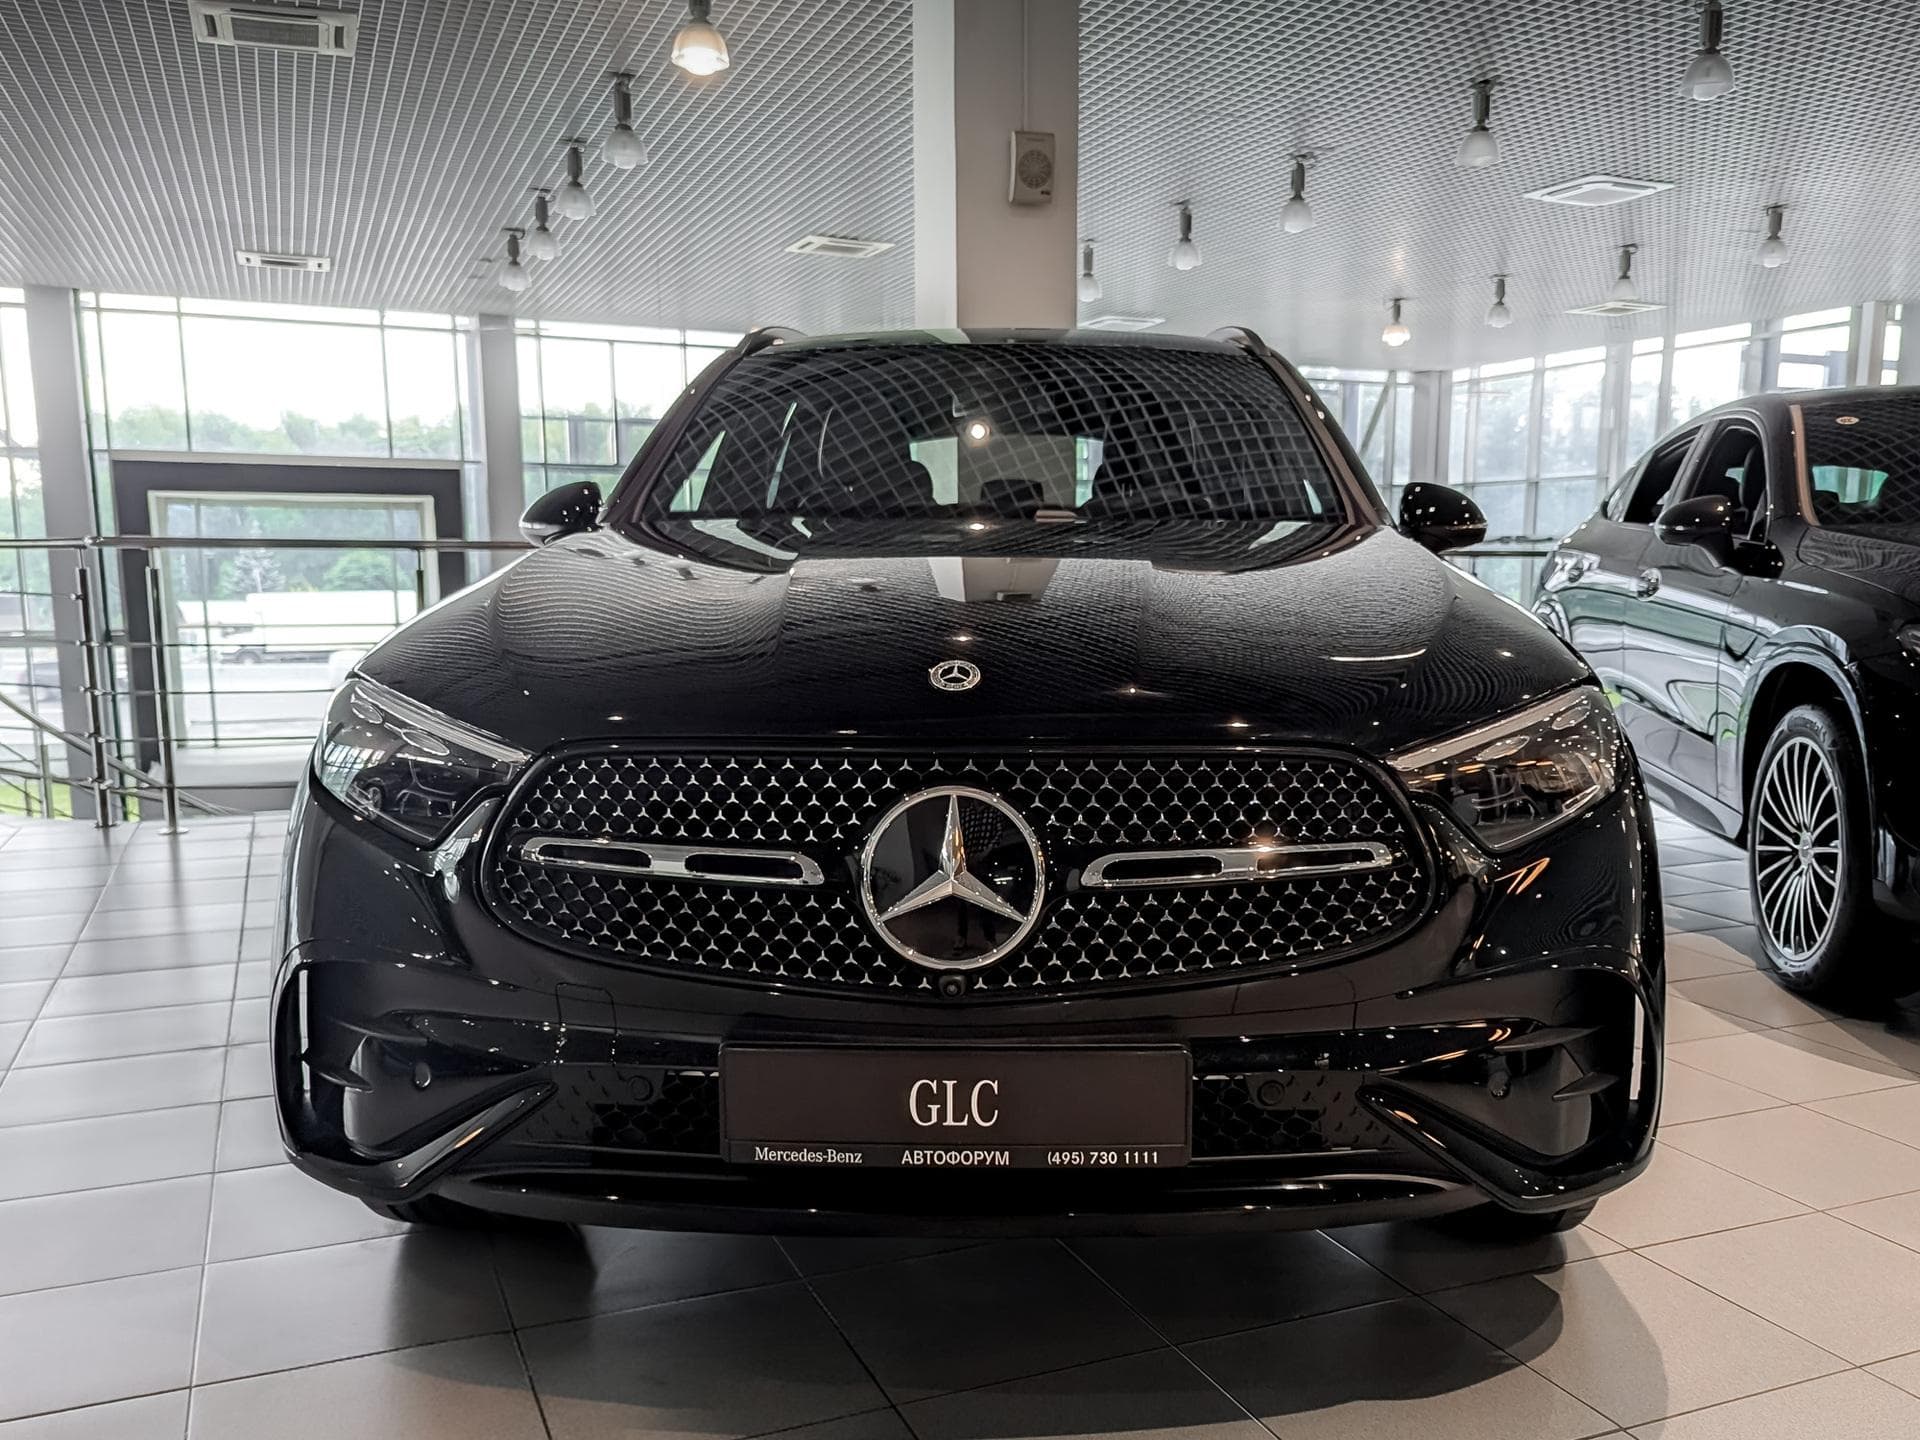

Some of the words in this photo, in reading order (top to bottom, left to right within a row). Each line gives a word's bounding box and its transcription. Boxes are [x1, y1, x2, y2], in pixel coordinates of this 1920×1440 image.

[909, 1079, 999, 1127] GLC
[754, 1146, 863, 1164] Mercedes-Benz
[901, 1150, 1010, 1166] АВТОФОРУМ
[1047, 1151, 1085, 1165] (495)
[1089, 1151, 1118, 1165] 730
[1123, 1151, 1158, 1165] 1111
